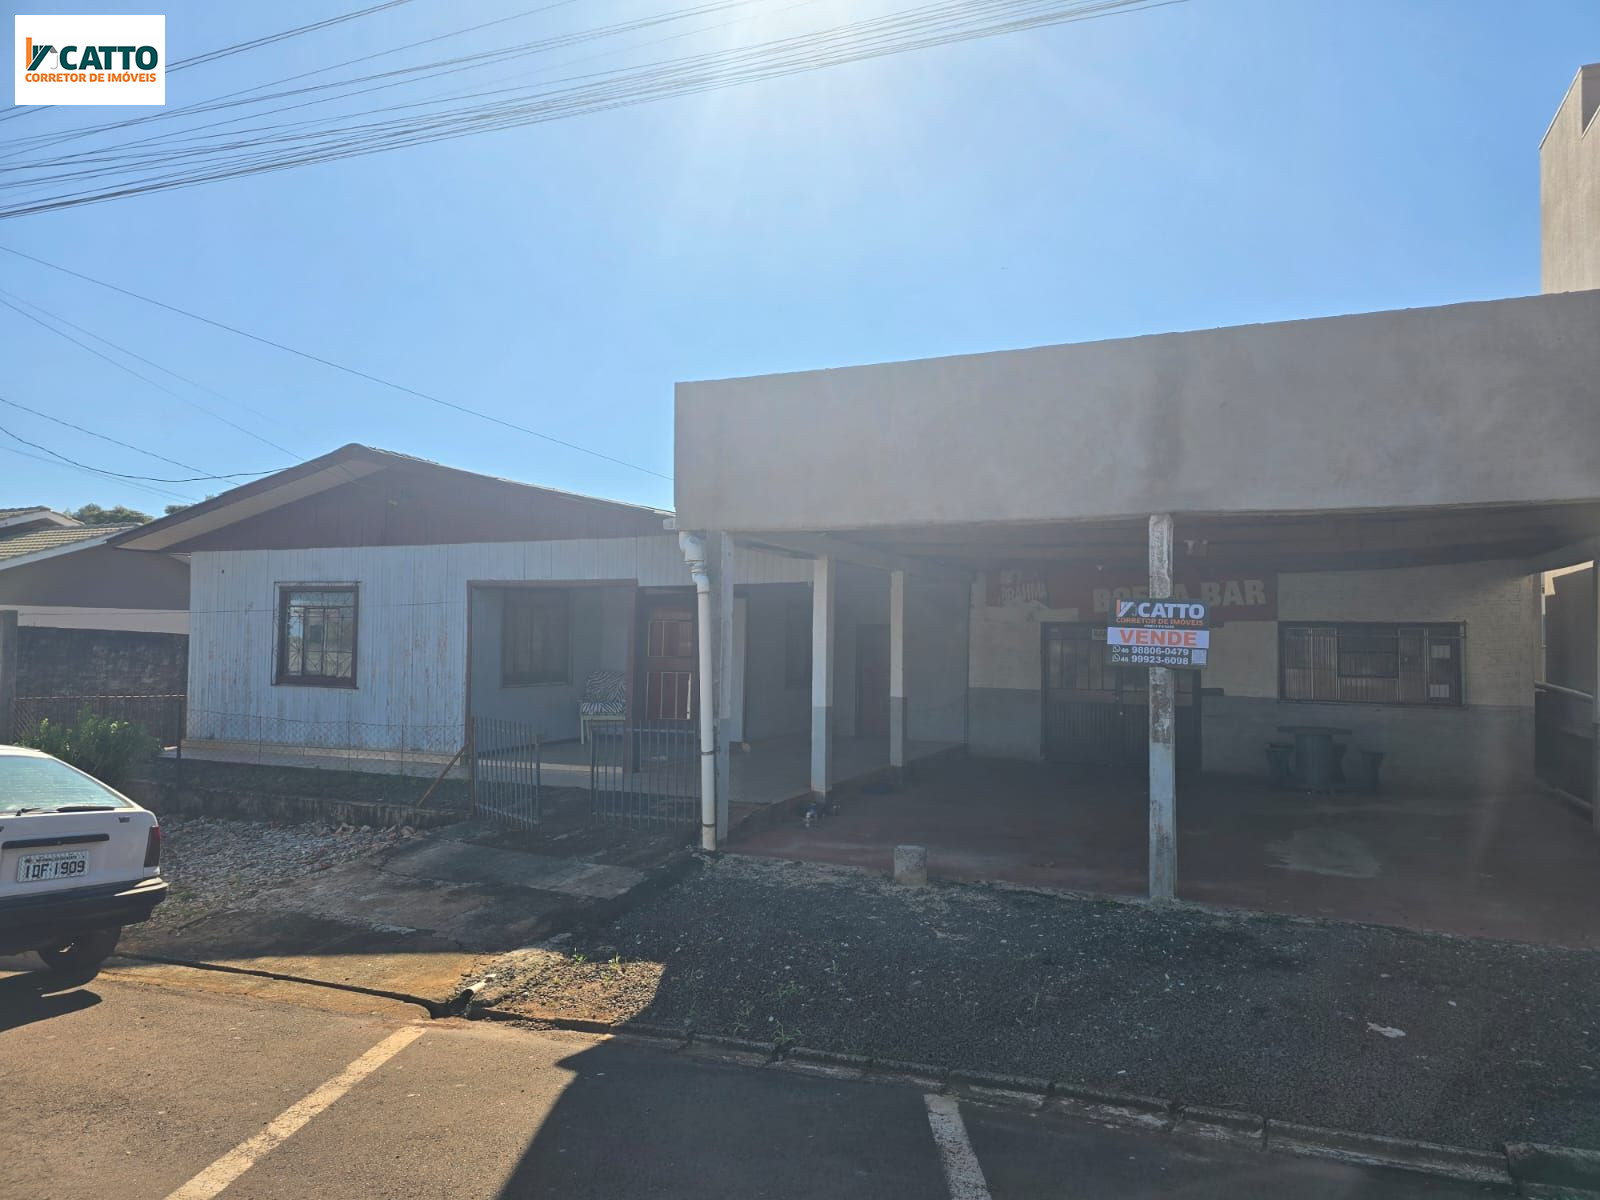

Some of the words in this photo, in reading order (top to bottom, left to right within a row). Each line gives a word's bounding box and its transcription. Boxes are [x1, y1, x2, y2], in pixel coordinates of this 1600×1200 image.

[1200, 579, 1267, 606] BAR
[1137, 602, 1205, 619] CATTO
[1116, 617, 1156, 625] CORRETOR
[1119, 629, 1197, 647] VENDE
[1131, 646, 1189, 656] 98806-0479
[1131, 655, 1189, 665] 99923-6098
